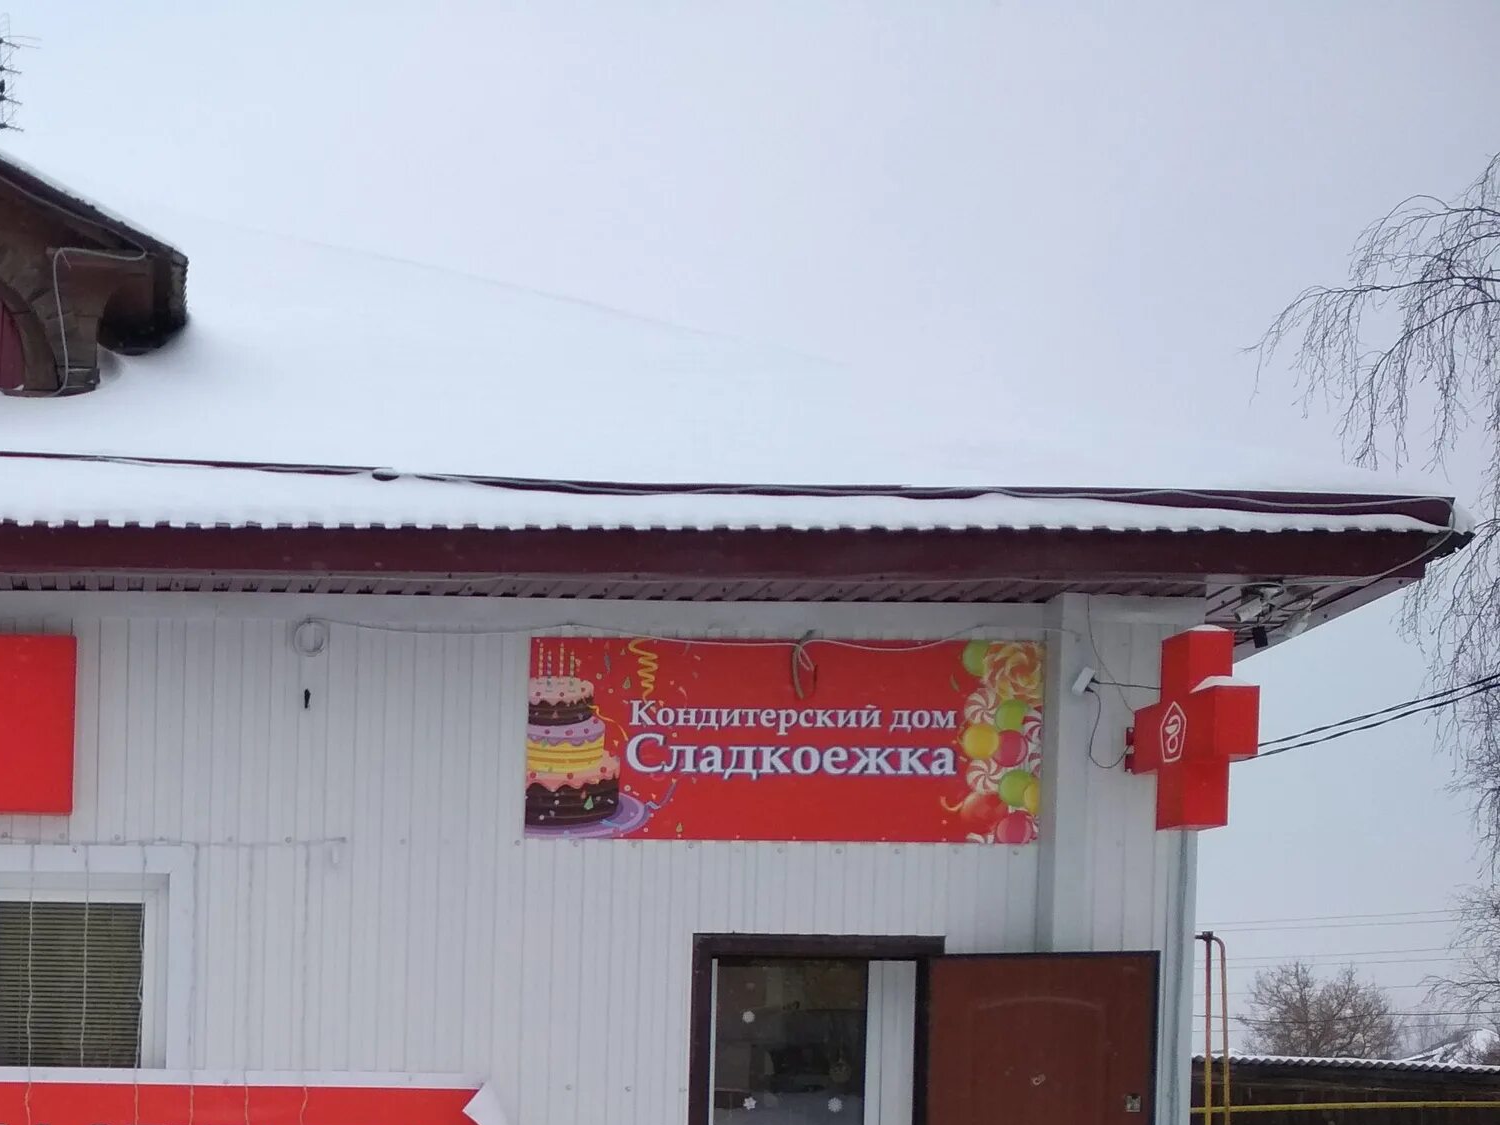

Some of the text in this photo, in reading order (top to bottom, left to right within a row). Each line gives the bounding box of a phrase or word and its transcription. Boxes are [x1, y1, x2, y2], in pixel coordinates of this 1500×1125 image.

[629, 699, 957, 735] Кондитерский дом
[624, 732, 957, 781] Сладкоежка
